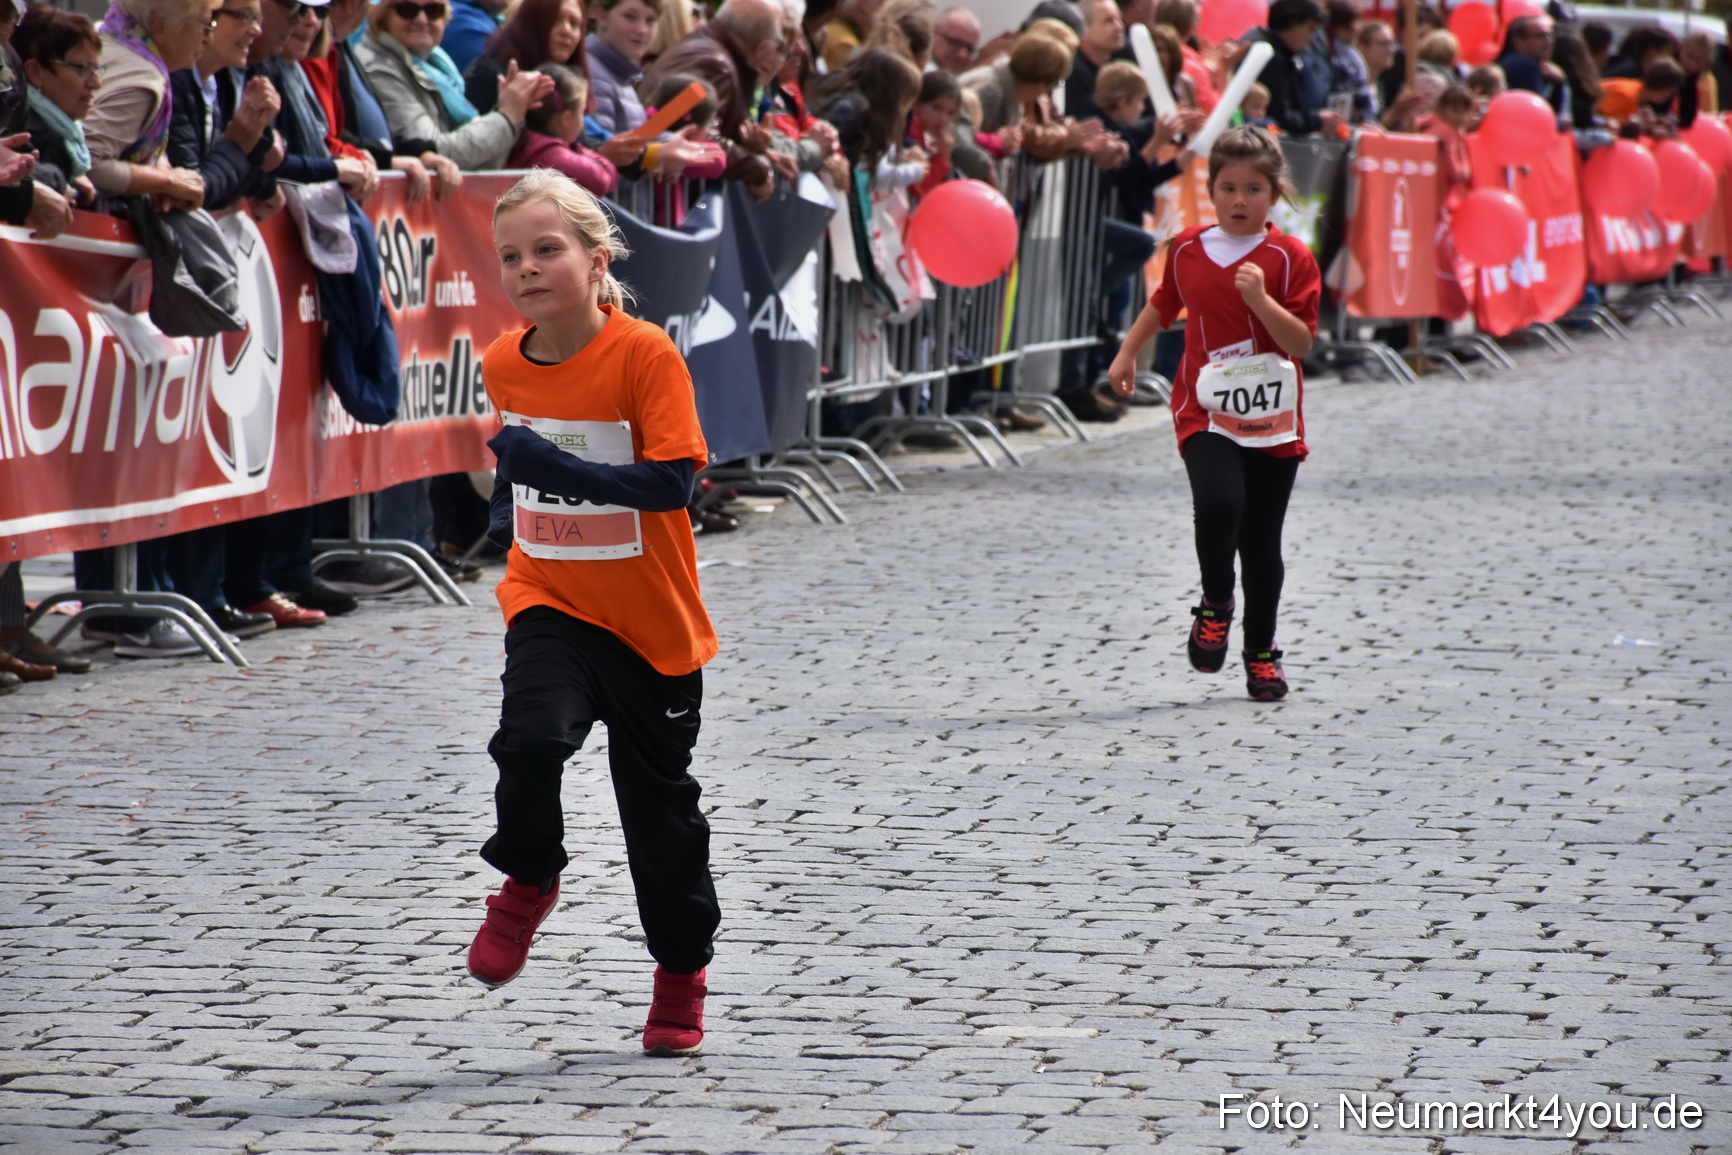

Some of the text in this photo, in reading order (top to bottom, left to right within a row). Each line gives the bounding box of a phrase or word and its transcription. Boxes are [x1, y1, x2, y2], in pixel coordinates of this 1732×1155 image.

[398, 339, 491, 421] ktuelle
[1213, 380, 1283, 415] 7047
[535, 515, 583, 542] EVA
